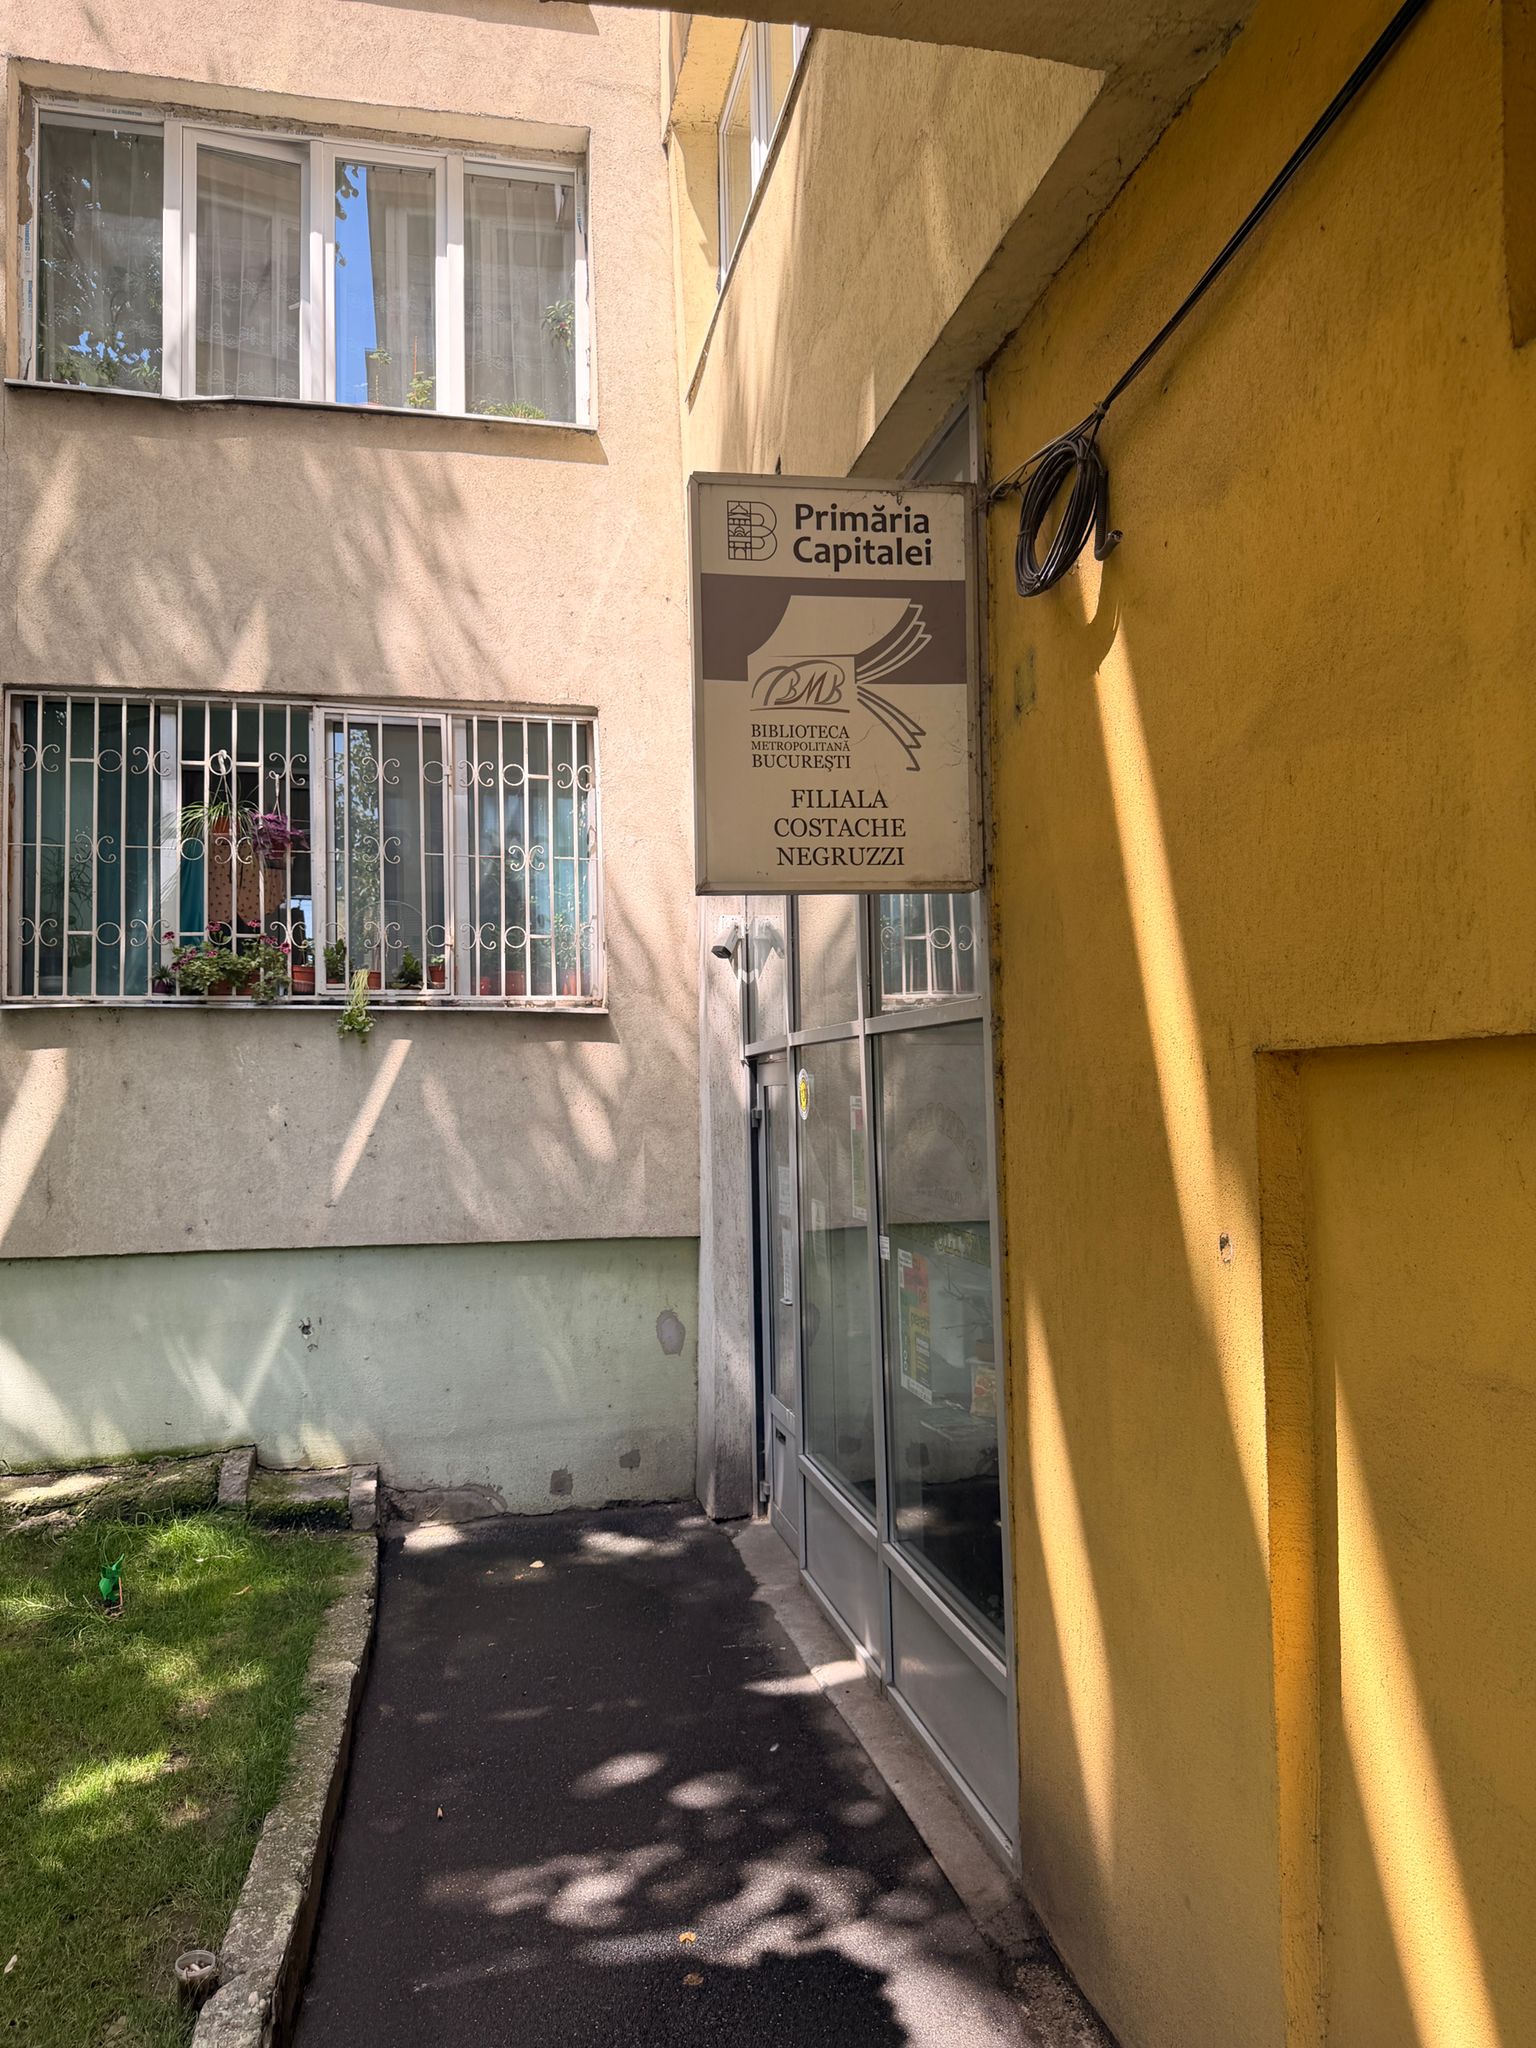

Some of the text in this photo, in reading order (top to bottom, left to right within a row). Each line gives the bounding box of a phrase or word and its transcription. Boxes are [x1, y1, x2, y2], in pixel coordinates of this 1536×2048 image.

[794, 503, 930, 535] Primăria
[793, 536, 932, 572] Capitalei
[751, 659, 846, 706] BMB
[751, 723, 850, 739] BIBLIOTECA
[751, 740, 851, 752] METROPOLITANĂ
[791, 789, 889, 809] FILIALA
[774, 817, 907, 838] COSTACHE
[776, 846, 905, 866] NEGRUZZI
